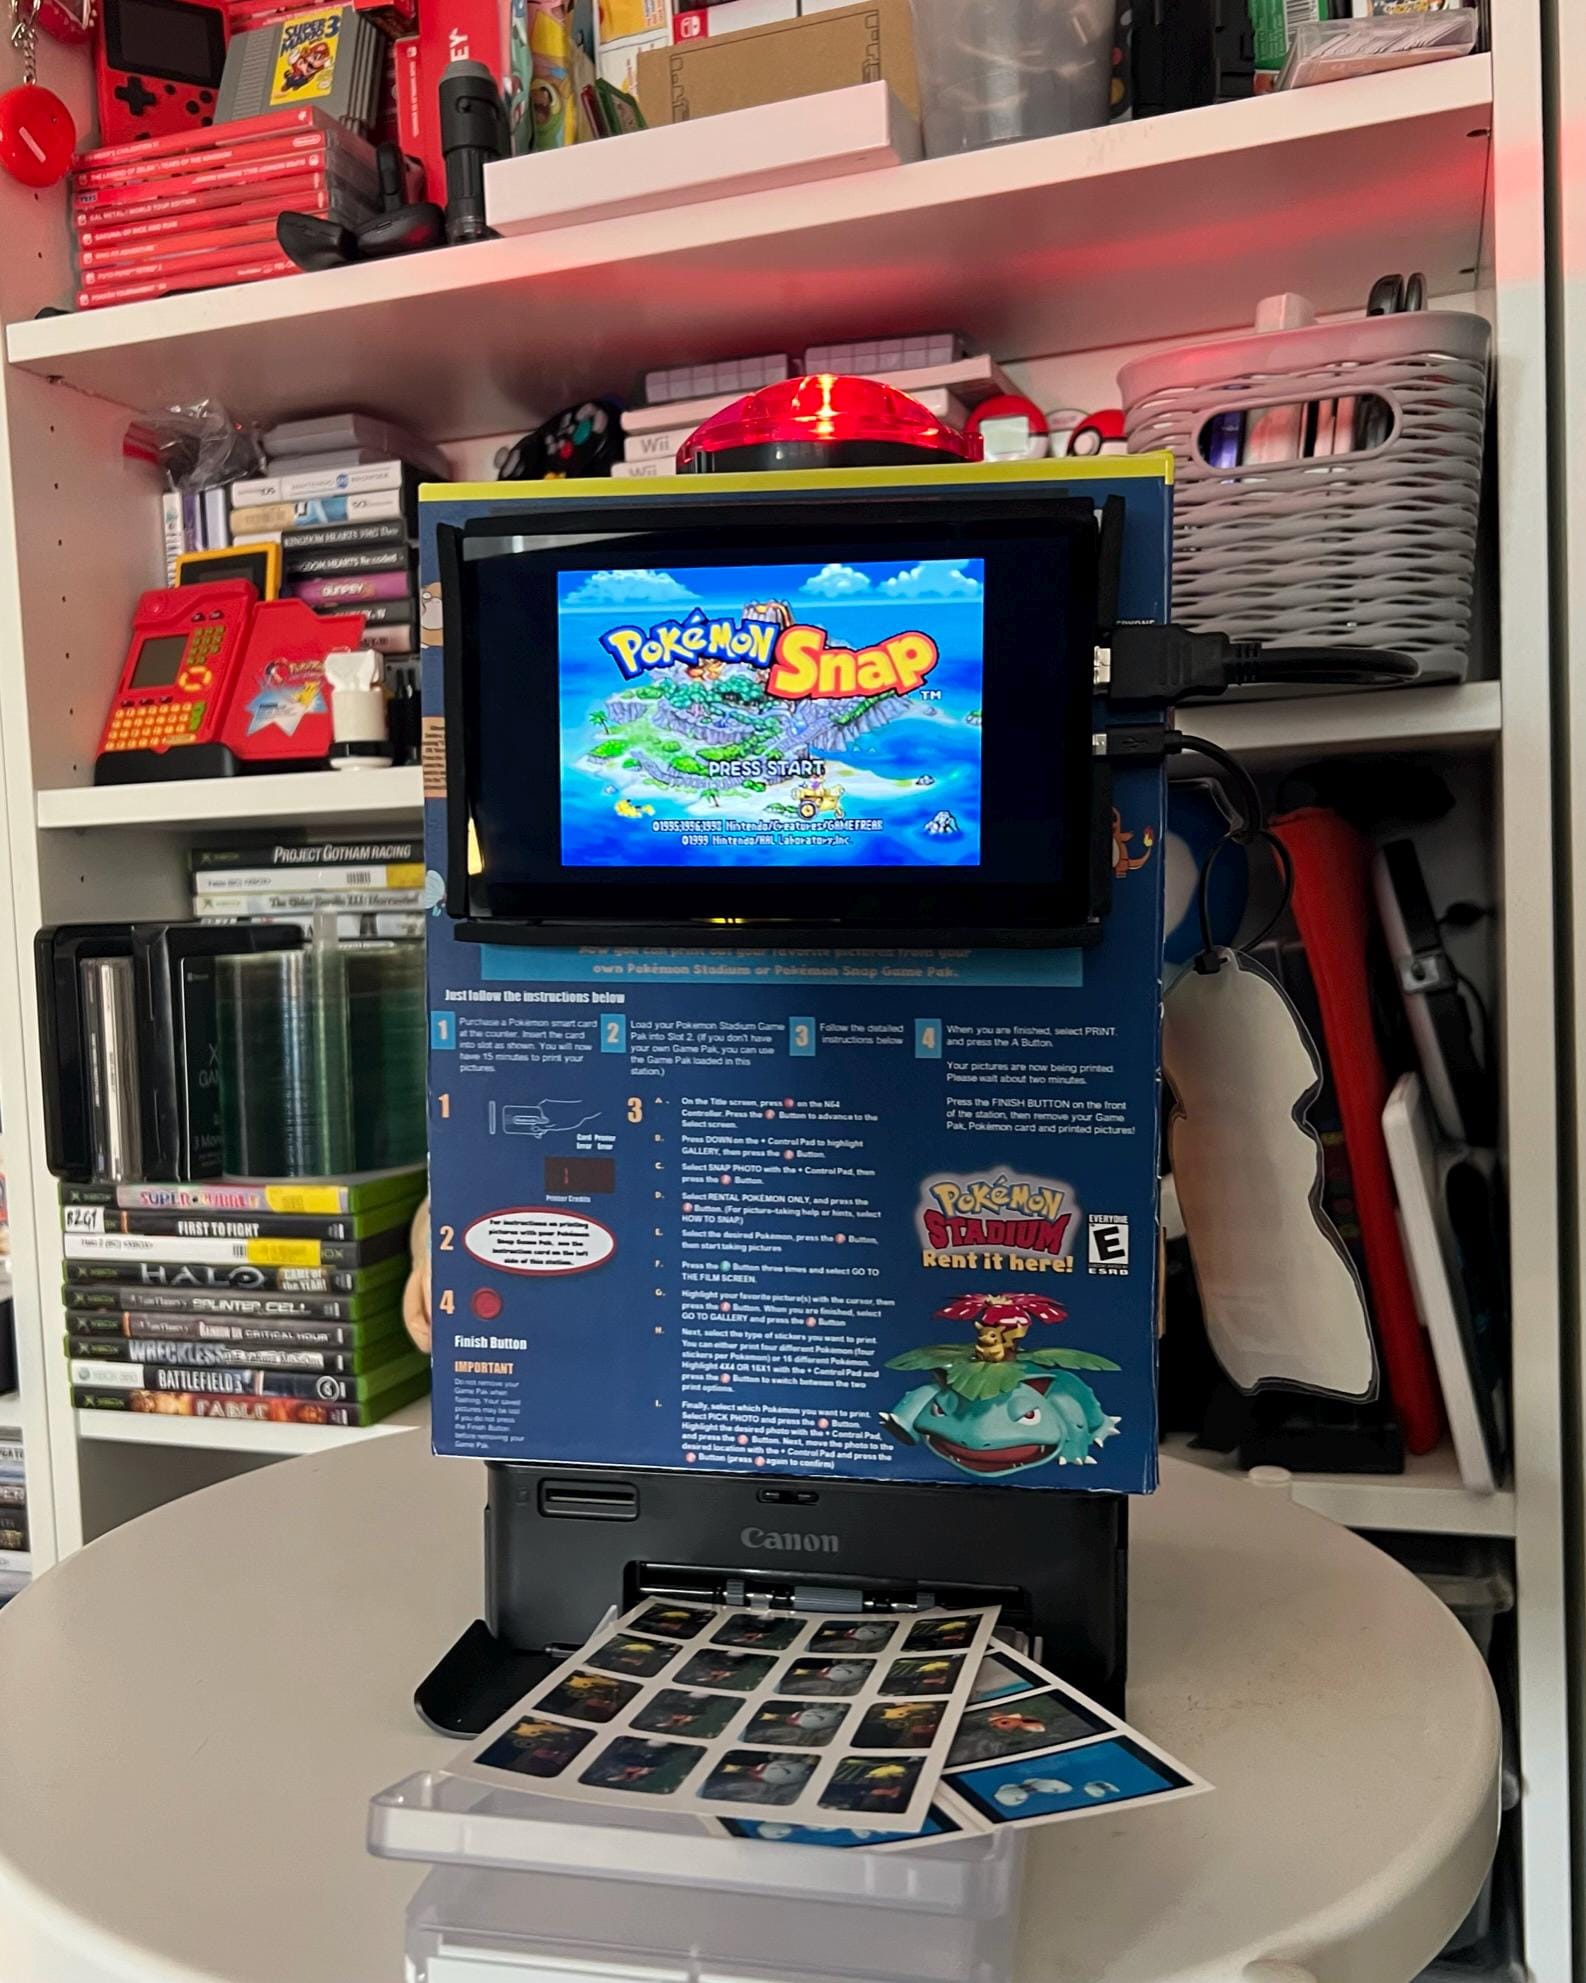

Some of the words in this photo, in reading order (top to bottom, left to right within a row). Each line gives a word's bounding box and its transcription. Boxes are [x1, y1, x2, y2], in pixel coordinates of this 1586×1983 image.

[284, 19, 324, 41] SUPER
[325, 14, 341, 39] 3
[641, 437, 671, 455] Wii
[600, 607, 781, 679] Pokémon
[767, 625, 939, 698] Snap
[709, 760, 761, 776] PRESS
[767, 760, 826, 776] START
[274, 846, 322, 863] PROJECT
[322, 844, 370, 861] GOTHAM
[371, 844, 411, 859] RACING
[593, 965, 625, 973] own
[624, 962, 692, 974] Pokémon
[691, 964, 752, 975] Stadium
[752, 967, 772, 975] or
[772, 964, 840, 976] Pokémon
[840, 966, 879, 978] Snap
[878, 968, 925, 977] Game
[924, 966, 959, 978] Pak.
[445, 989, 467, 1001] Just
[467, 989, 501, 1001] follow
[502, 990, 521, 1002] the
[522, 991, 589, 1003] instructions
[590, 991, 625, 1003] below
[437, 1019, 448, 1040] 1
[607, 1023, 618, 1043] 2
[630, 1020, 653, 1029] Load
[653, 1022, 674, 1030] your
[717, 1021, 756, 1030] Stadium
[756, 1022, 785, 1030] Game
[947, 1025, 974, 1033] When
[975, 1027, 994, 1035] you
[1012, 1026, 1051, 1035] finished,
[1053, 1027, 1083, 1035] select
[795, 1025, 809, 1047] 3
[821, 1036, 874, 1044] instructions
[875, 1036, 904, 1044] below
[921, 1026, 935, 1048] 4
[947, 1038, 964, 1046] and
[993, 1038, 1009, 1046] the
[1010, 1038, 1019, 1046] A
[947, 1072, 978, 1082] Please
[978, 1074, 998, 1082] wait
[999, 1074, 1027, 1083] about
[1028, 1075, 1046, 1083] two
[1047, 1076, 1087, 1084] minutes.
[438, 1093, 450, 1118] 1
[627, 1097, 643, 1123] 3
[682, 1097, 694, 1105] On
[709, 1097, 727, 1105] Title
[758, 1100, 783, 1108] press
[808, 1100, 822, 1108] the
[823, 1100, 840, 1108] N64
[947, 1097, 972, 1106] Press
[974, 1098, 990, 1106] the
[991, 1098, 1026, 1107] FINISH
[1026, 1098, 1070, 1108] BUTTON
[1085, 1101, 1102, 1109] the
[1103, 1101, 1126, 1109] front
[140, 1191, 191, 1206] SUPER
[929, 1175, 1065, 1220] Pokémon
[1088, 1214, 1128, 1223] EVERYONE
[177, 1221, 210, 1236] FIRST
[211, 1222, 226, 1236] TO
[226, 1222, 260, 1237] FIGHT
[439, 1225, 454, 1250] 2
[923, 1209, 1072, 1255] STADIUM
[1093, 1226, 1126, 1261] E
[923, 1251, 977, 1268] Rent
[984, 1252, 1003, 1270] it
[1009, 1254, 1074, 1273] here!
[140, 1263, 265, 1289] HALO
[682, 1272, 698, 1281] THE
[698, 1273, 720, 1282] FILM
[720, 1274, 756, 1283] SCREEN.
[1088, 1268, 1129, 1276] ESRB
[192, 1298, 262, 1313] SPLINTER
[265, 1300, 309, 1315] CELL
[439, 1289, 455, 1315] 4
[681, 1311, 696, 1320] GO
[695, 1312, 708, 1320] TO
[709, 1312, 748, 1322] GALLERY
[748, 1315, 765, 1323] and
[765, 1317, 789, 1325] press
[245, 1329, 294, 1341] CRITICAL
[296, 1331, 329, 1342] HOUR
[454, 1334, 488, 1348] Finish
[489, 1336, 527, 1350] Button
[129, 1339, 227, 1365] WRECKLESS
[454, 1360, 513, 1374] IMPORTANT
[158, 1369, 233, 1391] BATTLEFIELD
[196, 1400, 269, 1420] FABLE
[740, 1527, 839, 1553] Canon
